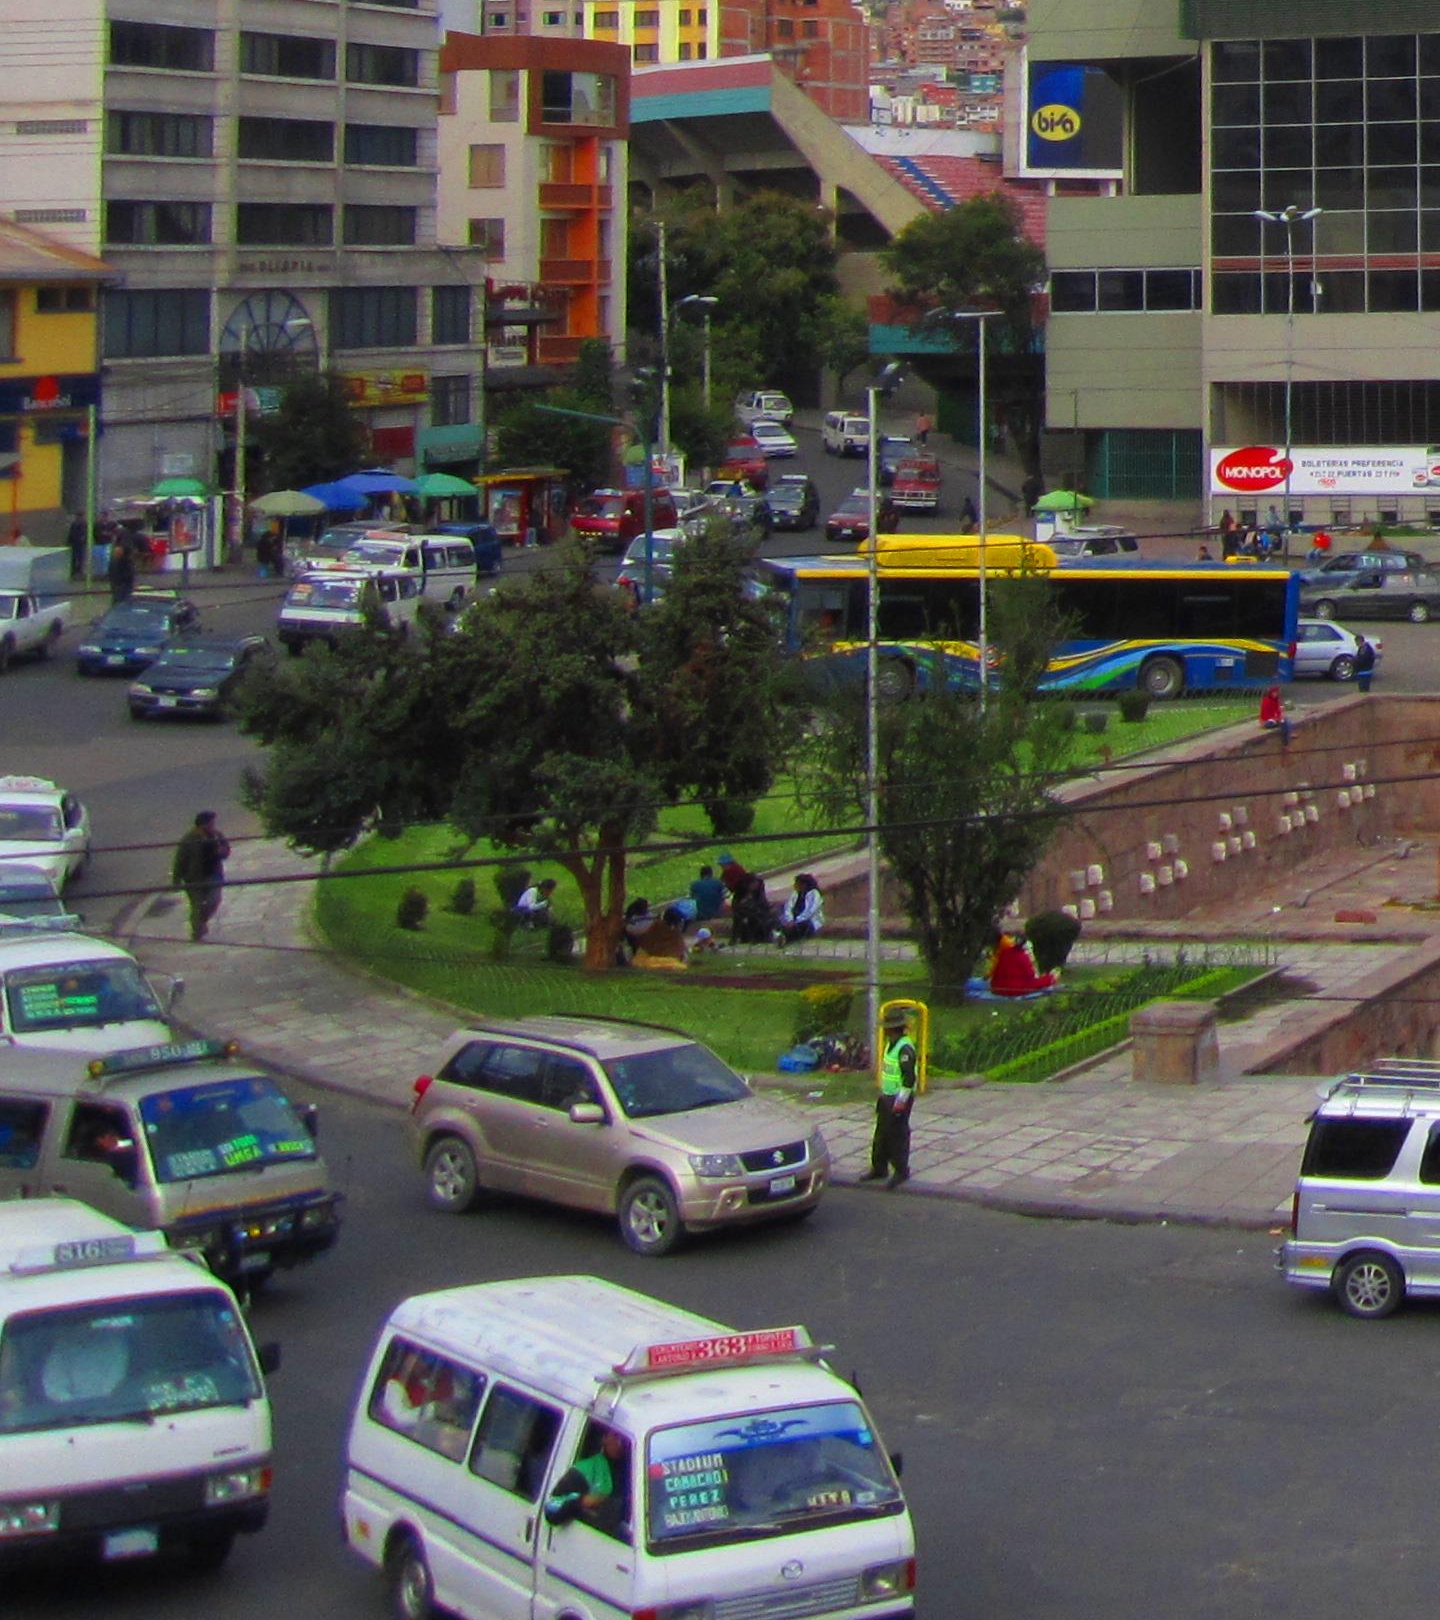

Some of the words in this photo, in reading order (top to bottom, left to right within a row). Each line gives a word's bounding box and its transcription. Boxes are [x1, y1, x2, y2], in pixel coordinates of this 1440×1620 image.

[1225, 466, 1283, 479] MONOPOL
[699, 1336, 747, 1359] 363
[661, 1453, 724, 1475] STADIUM
[669, 1489, 720, 1508] PEREZ
